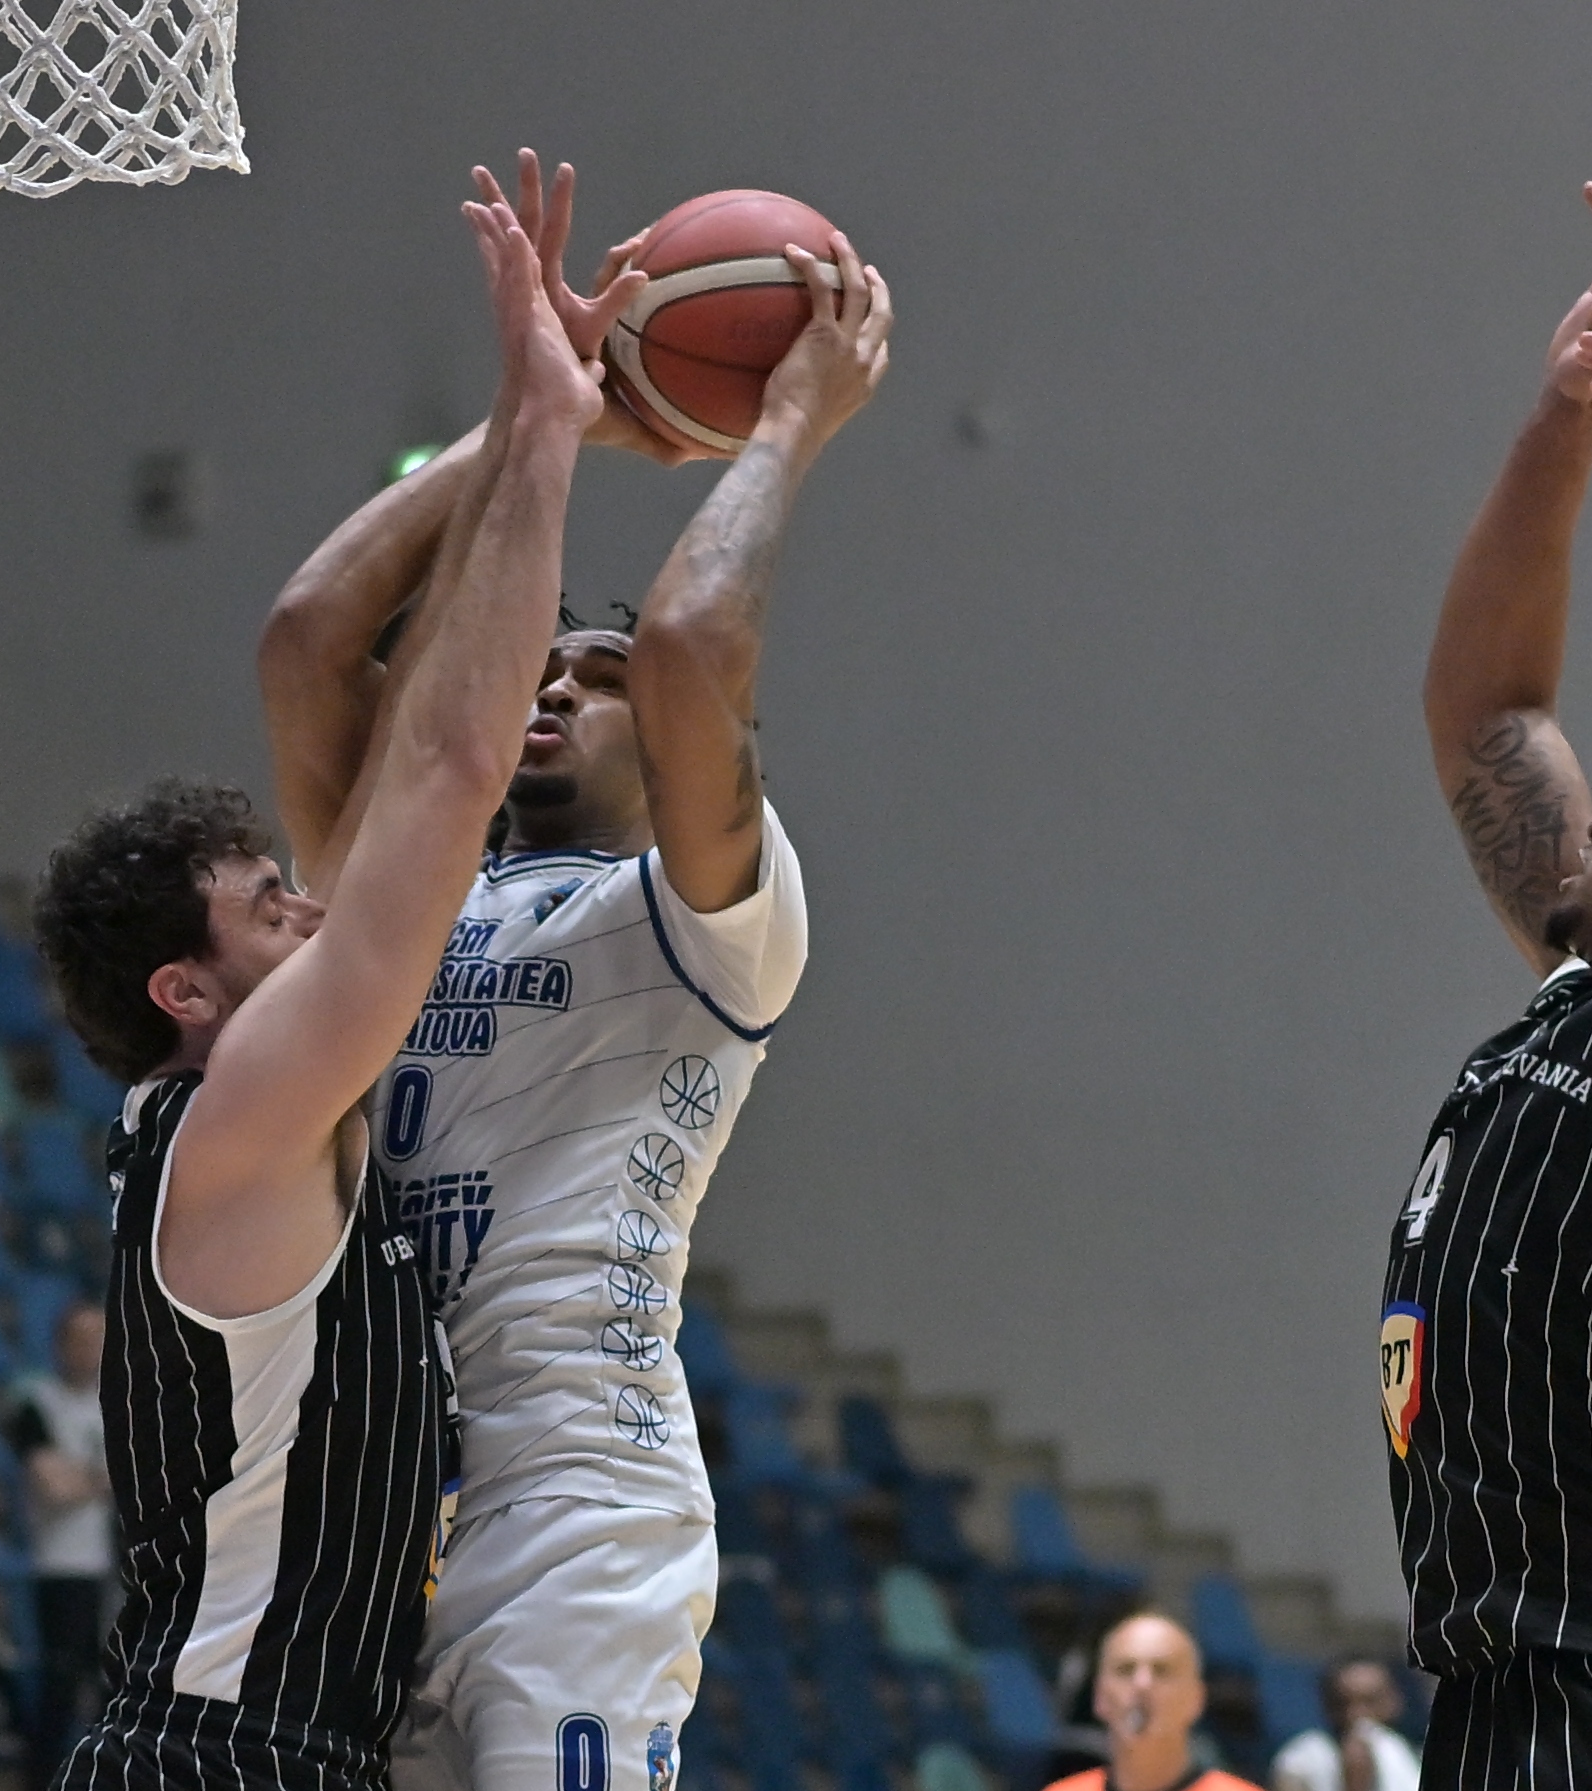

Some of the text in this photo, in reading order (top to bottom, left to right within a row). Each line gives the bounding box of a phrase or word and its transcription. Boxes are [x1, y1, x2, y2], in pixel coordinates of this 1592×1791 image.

[444, 920, 500, 955] CM
[430, 961, 567, 1004] SITATEA
[383, 1064, 433, 1162] 0
[1401, 1130, 1453, 1246] 4
[380, 1234, 415, 1267] U-B
